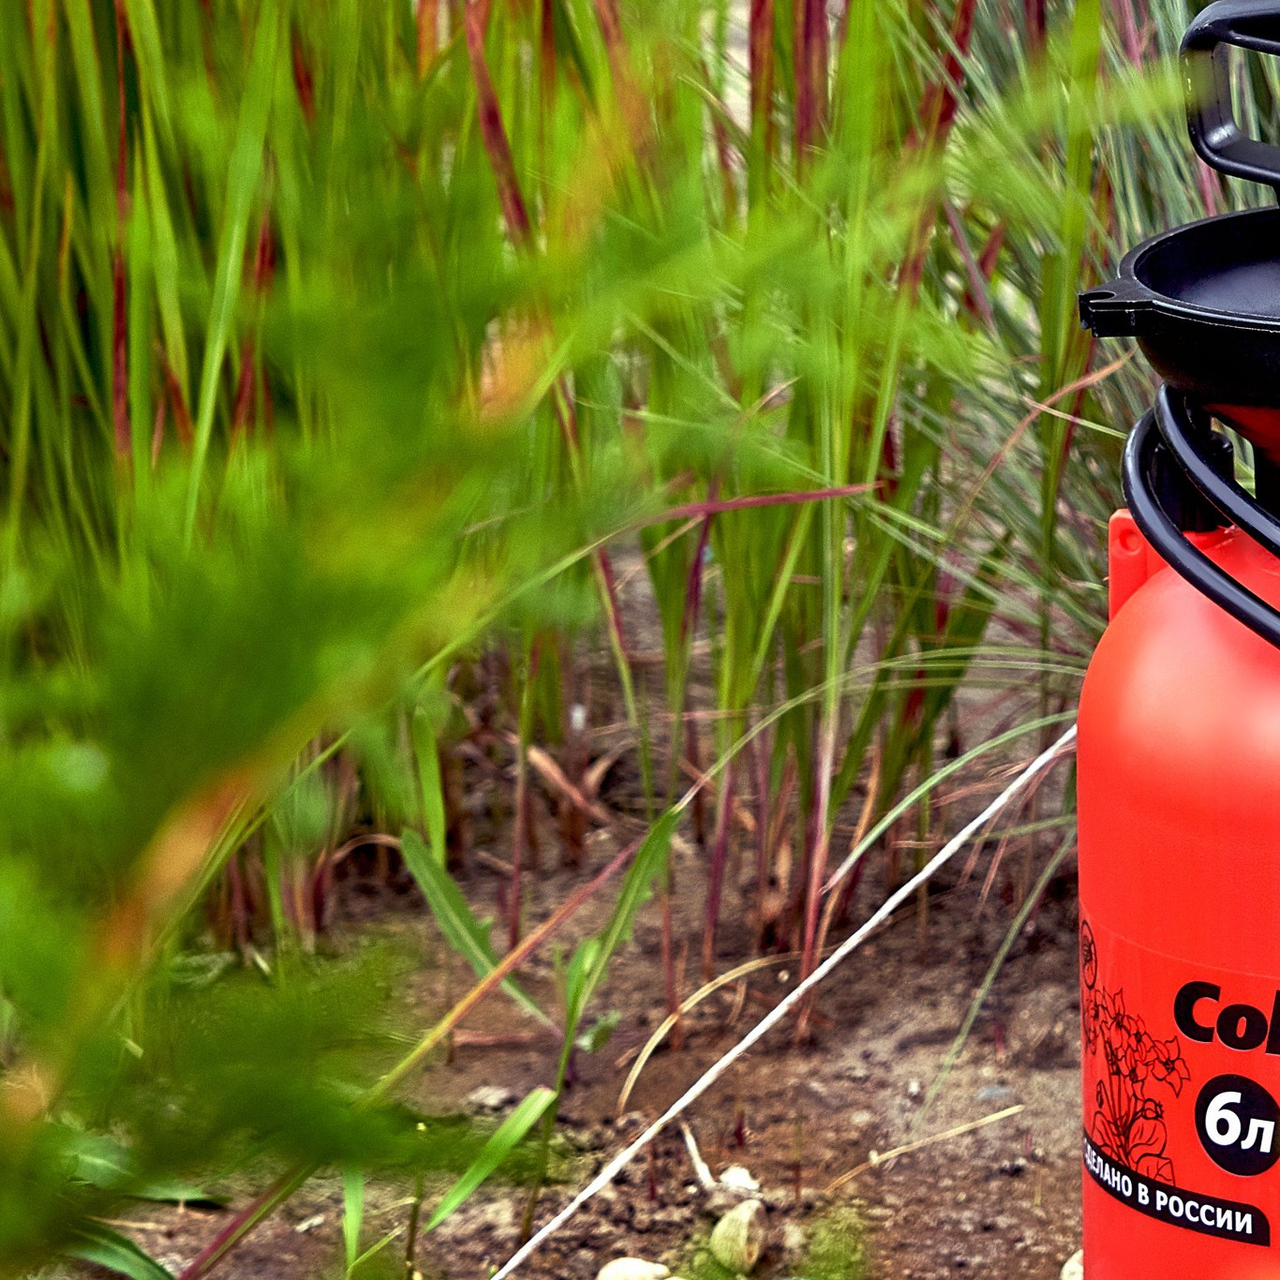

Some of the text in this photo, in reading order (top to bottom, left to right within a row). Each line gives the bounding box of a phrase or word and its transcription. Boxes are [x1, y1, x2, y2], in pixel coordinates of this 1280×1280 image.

[1204, 1091, 1276, 1153] 6л
[1138, 1182, 1149, 1205] В
[1156, 1190, 1252, 1234] РОССИИ
